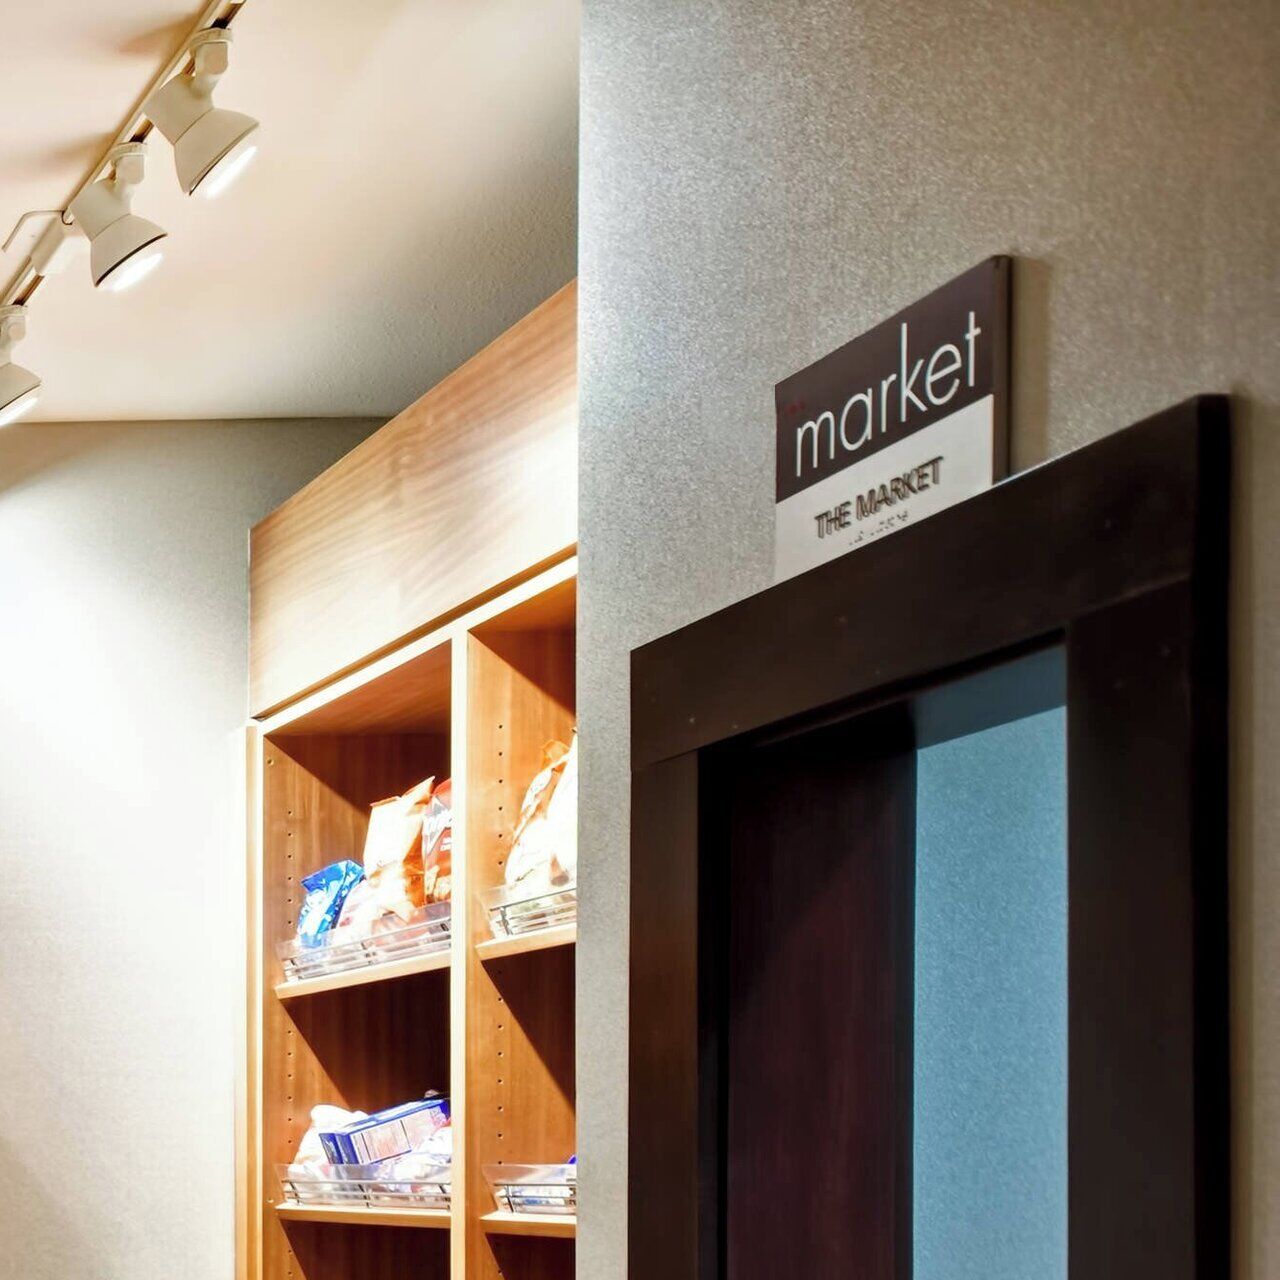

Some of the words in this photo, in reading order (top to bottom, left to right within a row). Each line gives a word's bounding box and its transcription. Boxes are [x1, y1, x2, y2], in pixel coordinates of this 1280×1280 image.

[796, 311, 982, 477] market
[814, 500, 852, 539] THE
[855, 455, 944, 521] MARKET
